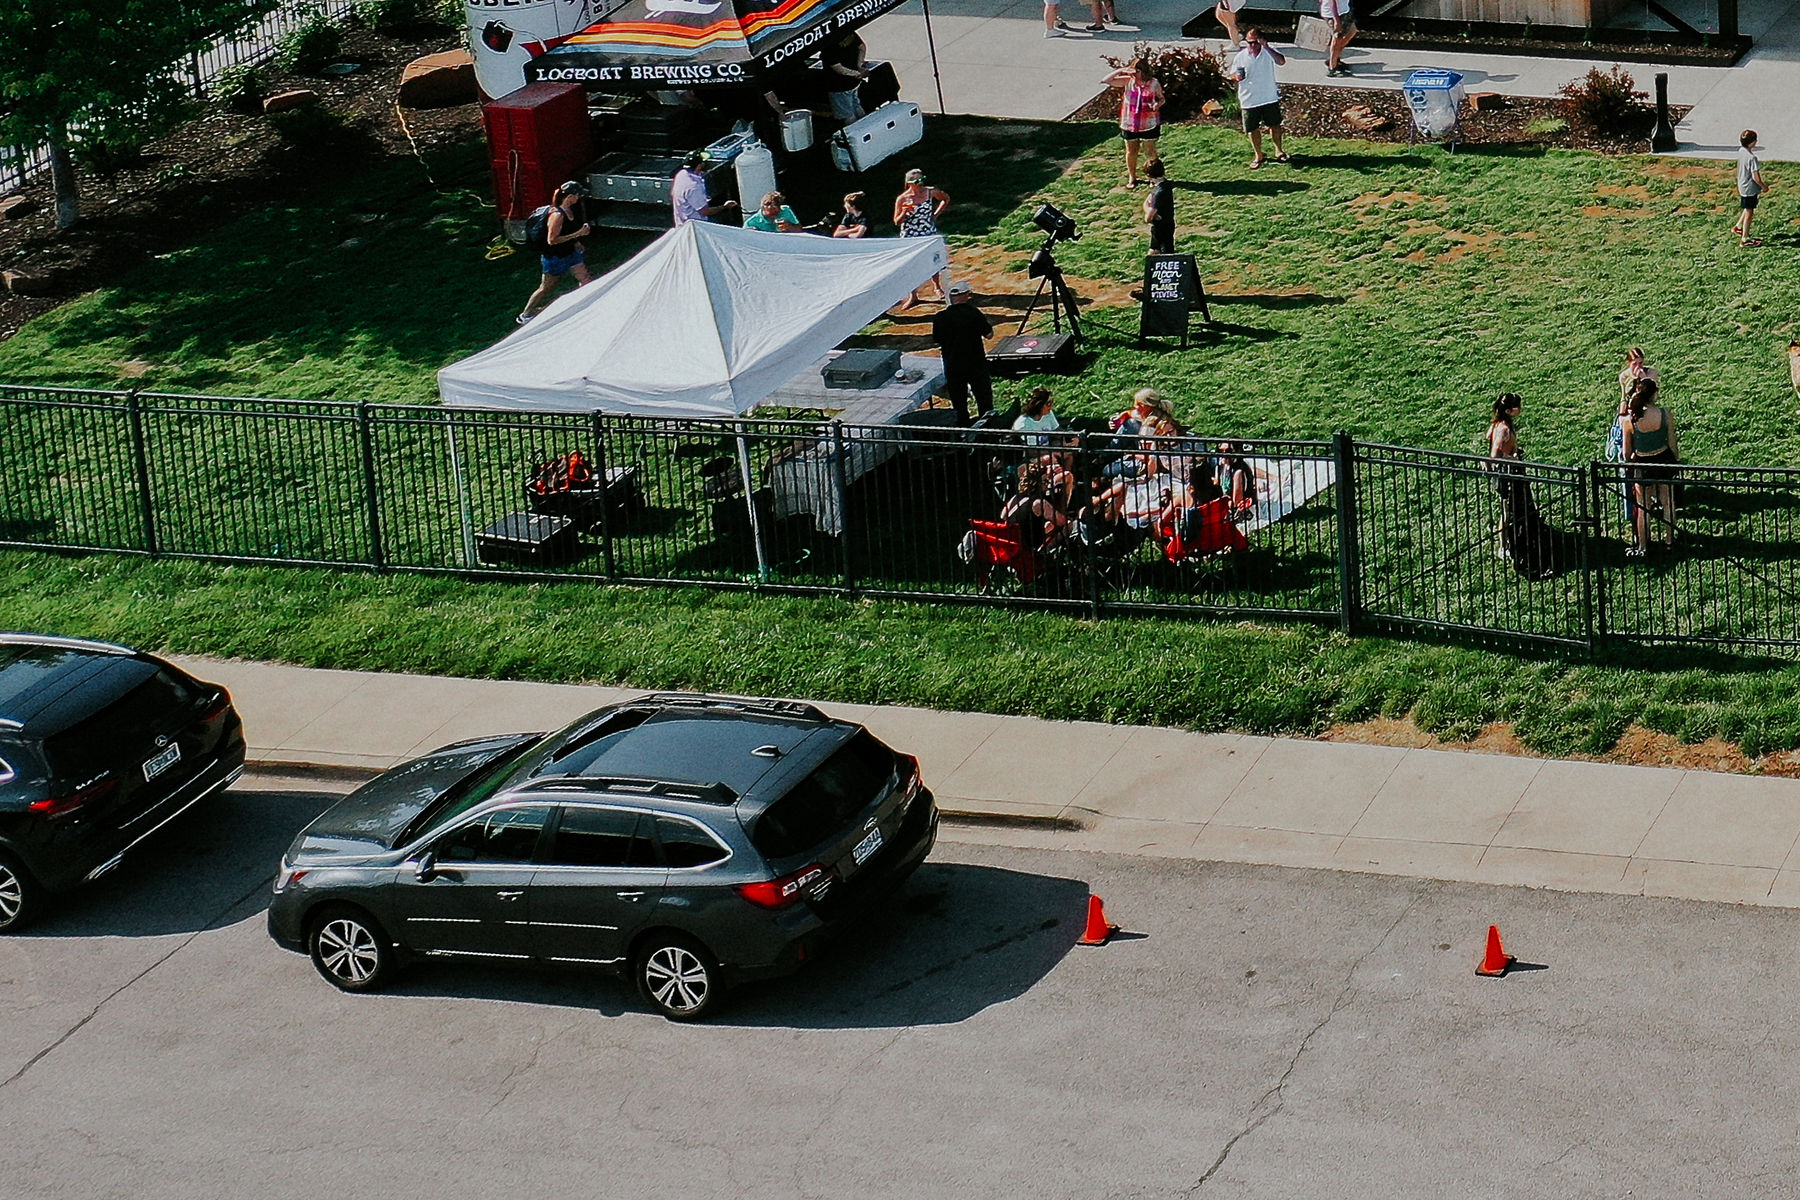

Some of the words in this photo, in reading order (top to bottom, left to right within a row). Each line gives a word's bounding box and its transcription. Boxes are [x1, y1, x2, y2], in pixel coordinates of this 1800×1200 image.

[763, 20, 832, 68] LOGBOAT
[1595, 43, 1642, 62] ARCADE
[536, 66, 623, 81] LOGBOAT
[630, 64, 712, 80] BREWING
[716, 63, 746, 77] CO.
[1155, 261, 1180, 271] FREE
